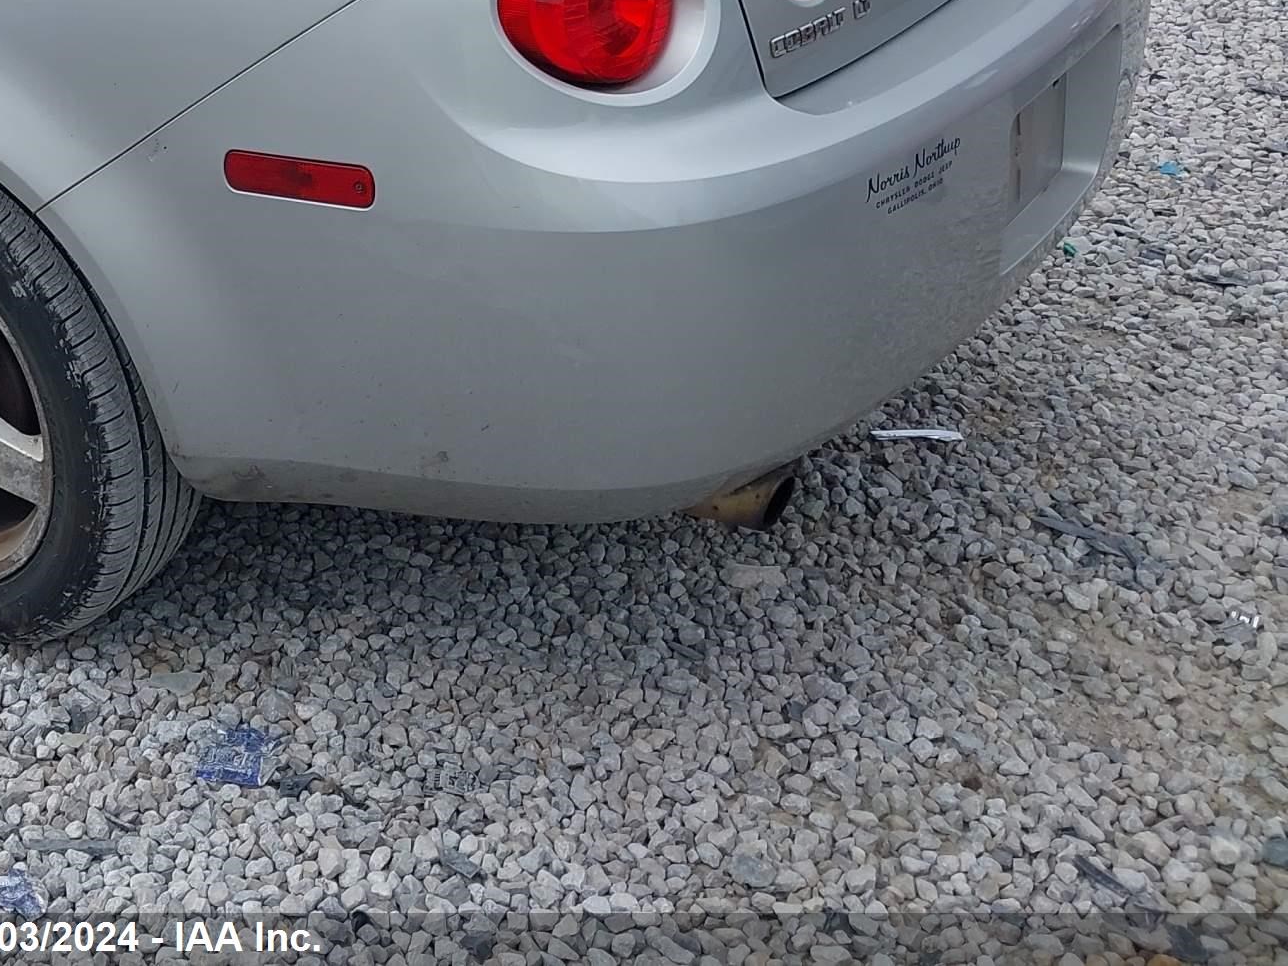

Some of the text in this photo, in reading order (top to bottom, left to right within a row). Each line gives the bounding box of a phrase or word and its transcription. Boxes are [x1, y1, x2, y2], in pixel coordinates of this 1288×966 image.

[770, 6, 846, 58] COBALT
[865, 137, 961, 203] Norris Northup
